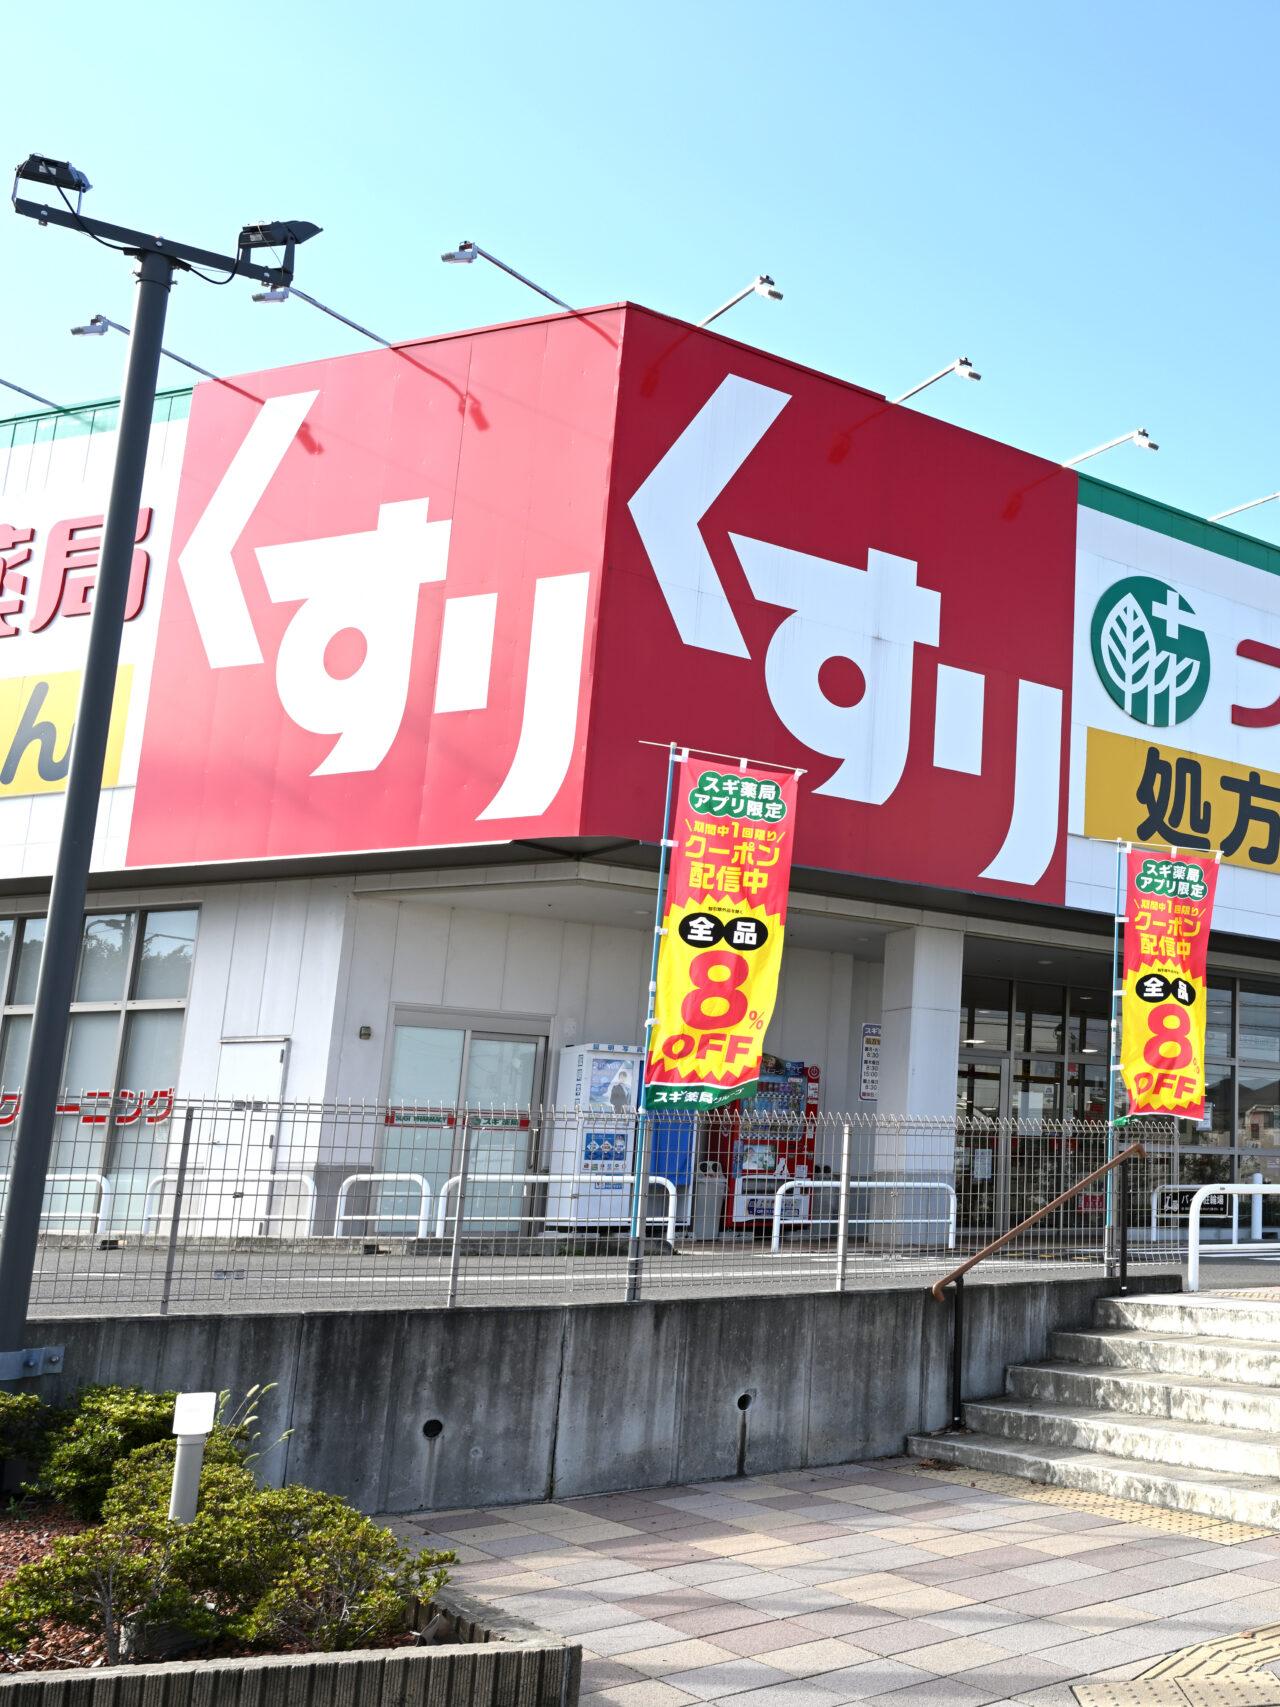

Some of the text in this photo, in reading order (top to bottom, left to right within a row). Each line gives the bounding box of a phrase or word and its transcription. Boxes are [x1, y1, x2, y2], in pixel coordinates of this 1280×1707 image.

[179, 389, 590, 821] くすり
[628, 373, 1064, 887] くすり
[703, 777, 776, 800] スギ薬局
[694, 793, 783, 818] アプリ限定
[685, 834, 780, 867] クーポン
[688, 861, 769, 895] 配信中
[1140, 876, 1205, 898] アプリ限定
[1146, 863, 1201, 883] スギ薬局
[687, 916, 758, 945] 全品
[1134, 911, 1201, 937] クーポン
[1140, 932, 1191, 961] 配信中
[1143, 976, 1189, 1002] 全品
[662, 1033, 754, 1063] OFF
[1133, 1071, 1197, 1100] OFF
[0, 1088, 175, 1126] クーニング
[1181, 1194, 1224, 1205] バ駐輪場
